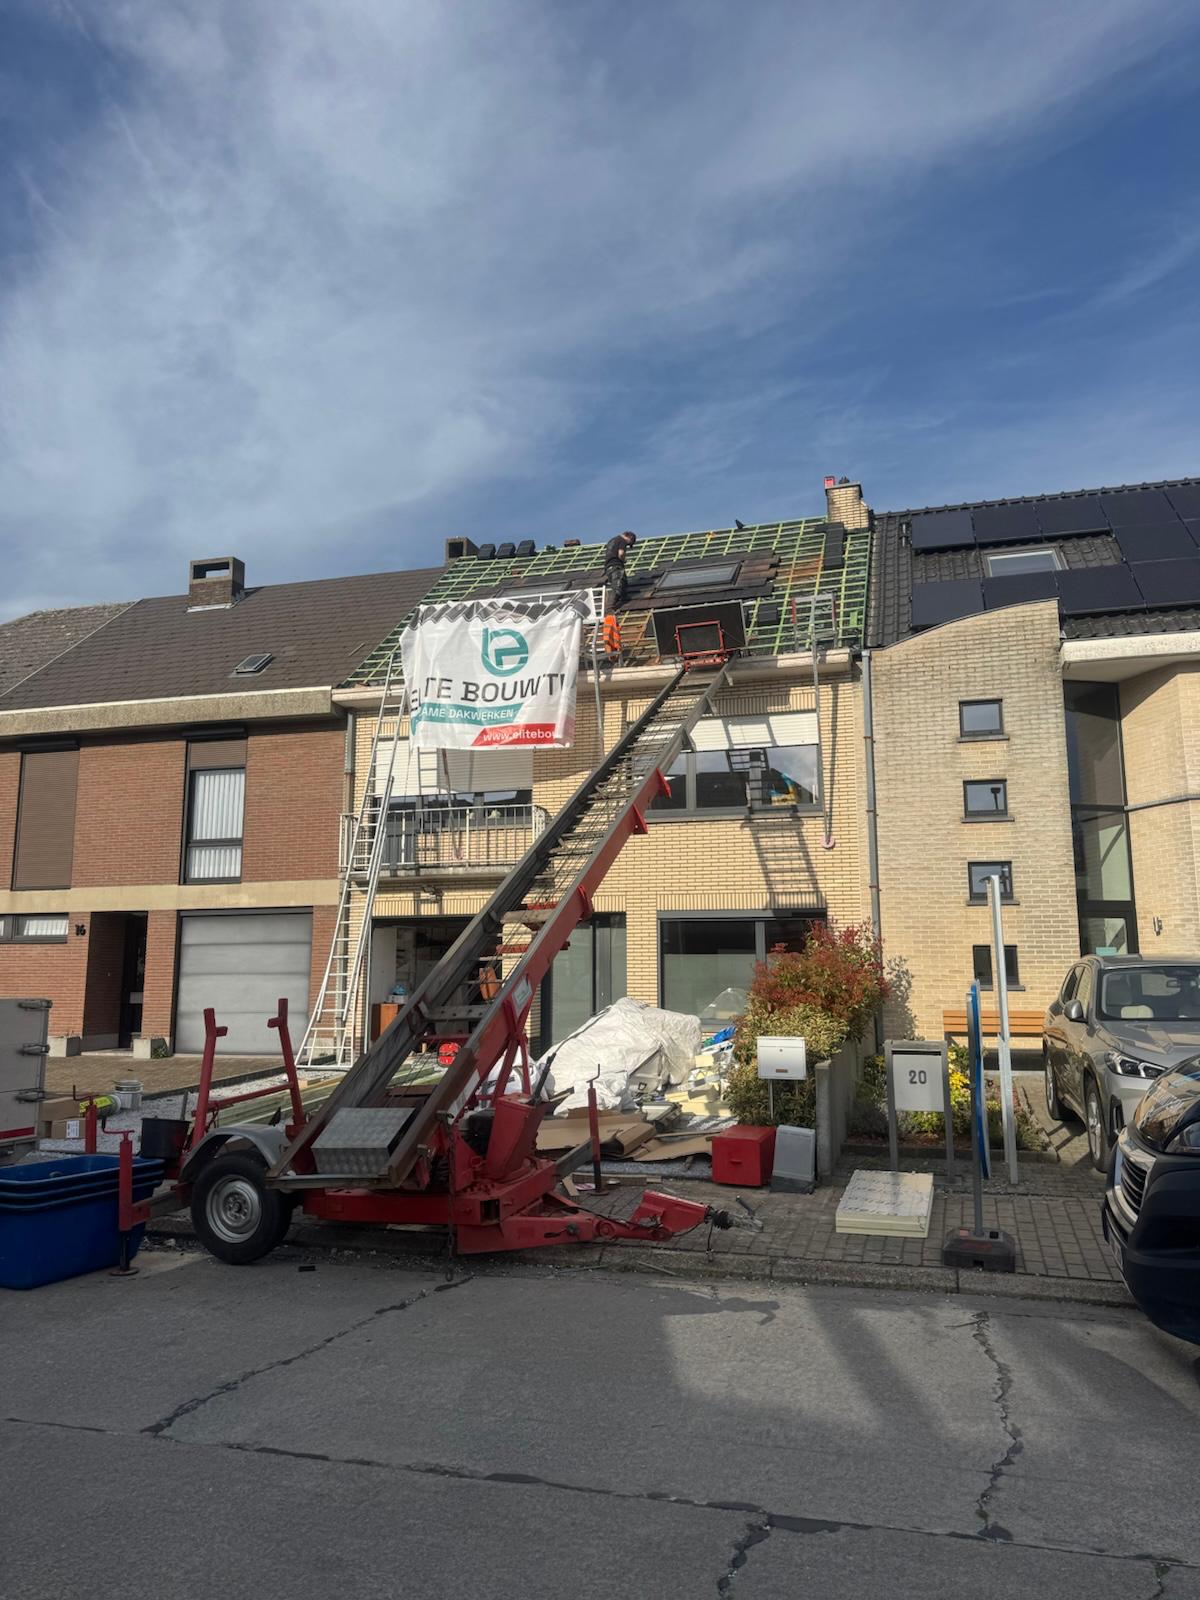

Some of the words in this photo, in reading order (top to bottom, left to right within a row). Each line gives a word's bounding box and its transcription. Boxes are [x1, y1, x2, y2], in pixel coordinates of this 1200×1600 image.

[449, 708, 514, 721] DAKWERKEN
[483, 728, 555, 742] www.elitebo
[909, 1070, 927, 1084] 20
